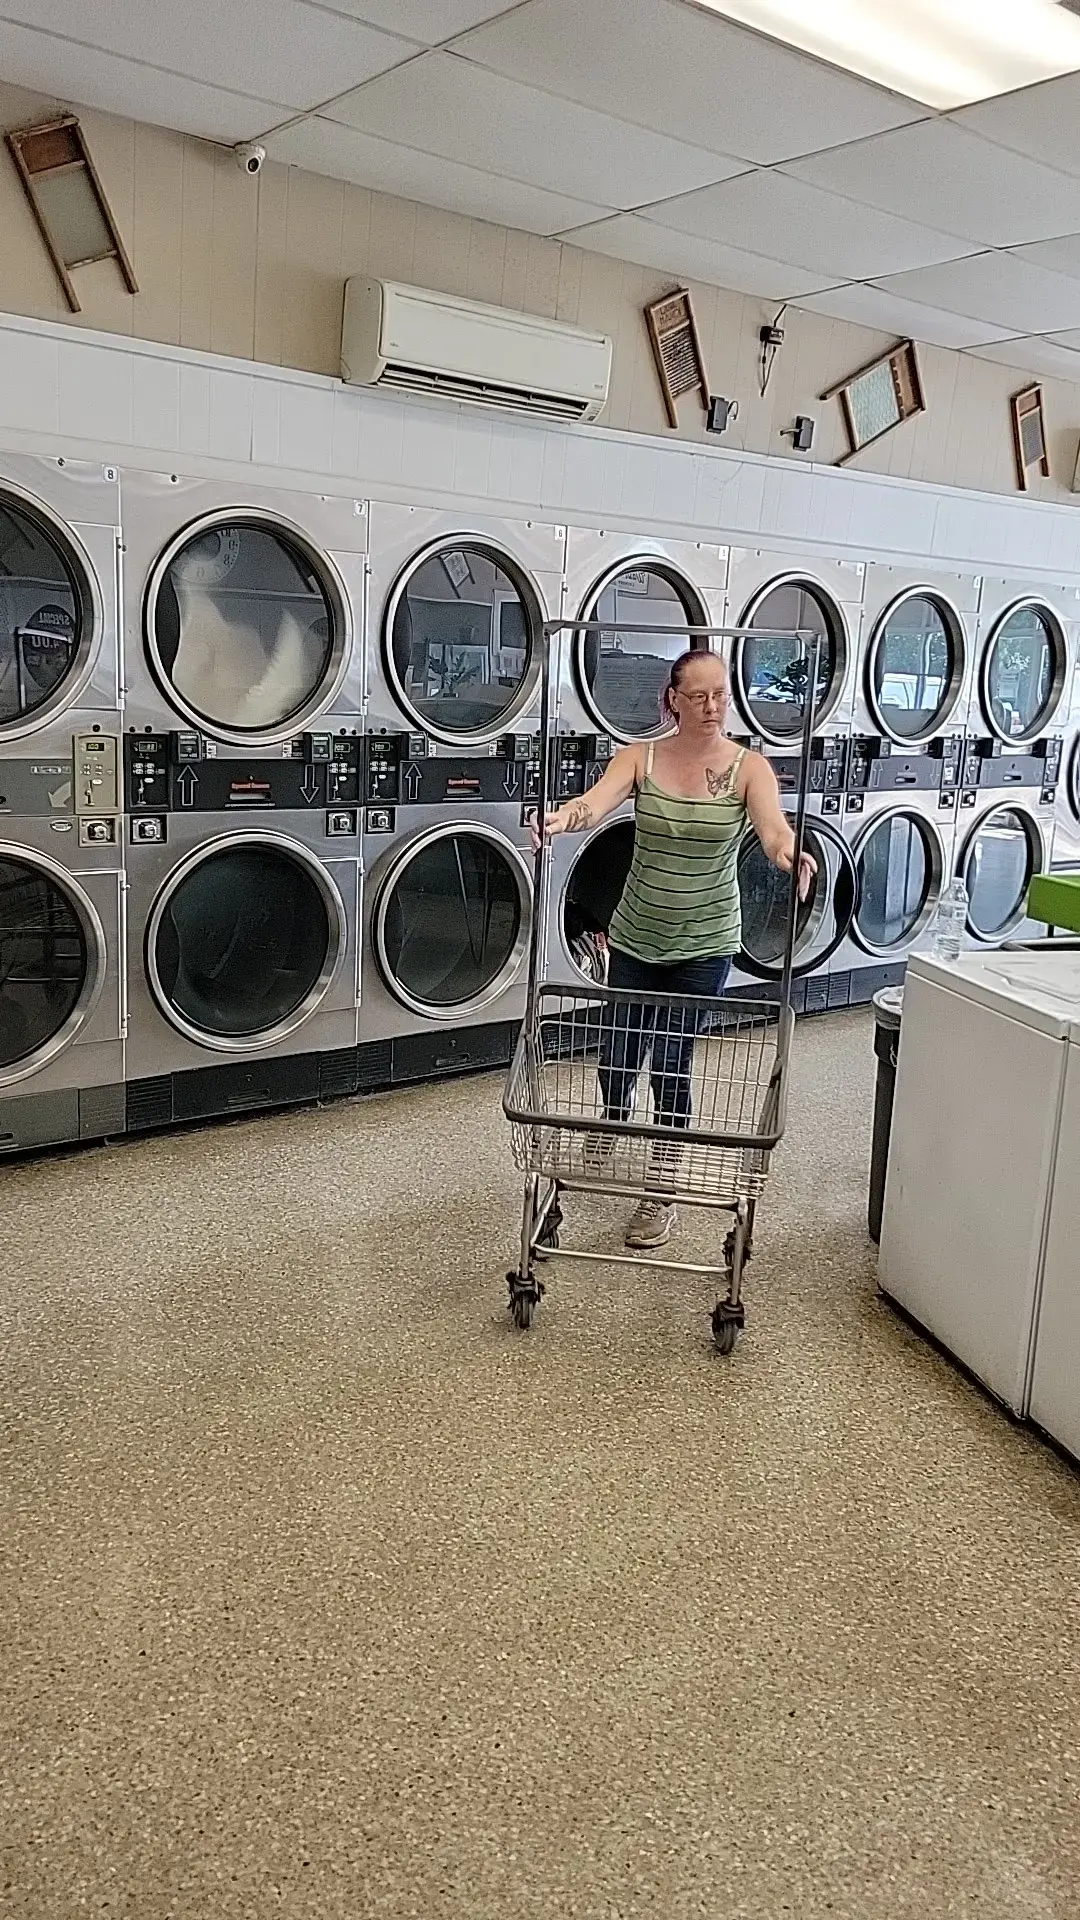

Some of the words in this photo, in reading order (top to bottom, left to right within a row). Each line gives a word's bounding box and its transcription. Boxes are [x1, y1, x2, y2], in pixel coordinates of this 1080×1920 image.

[107, 469, 114, 480] 8
[357, 503, 363, 514] 7
[558, 529, 563, 538] 6
